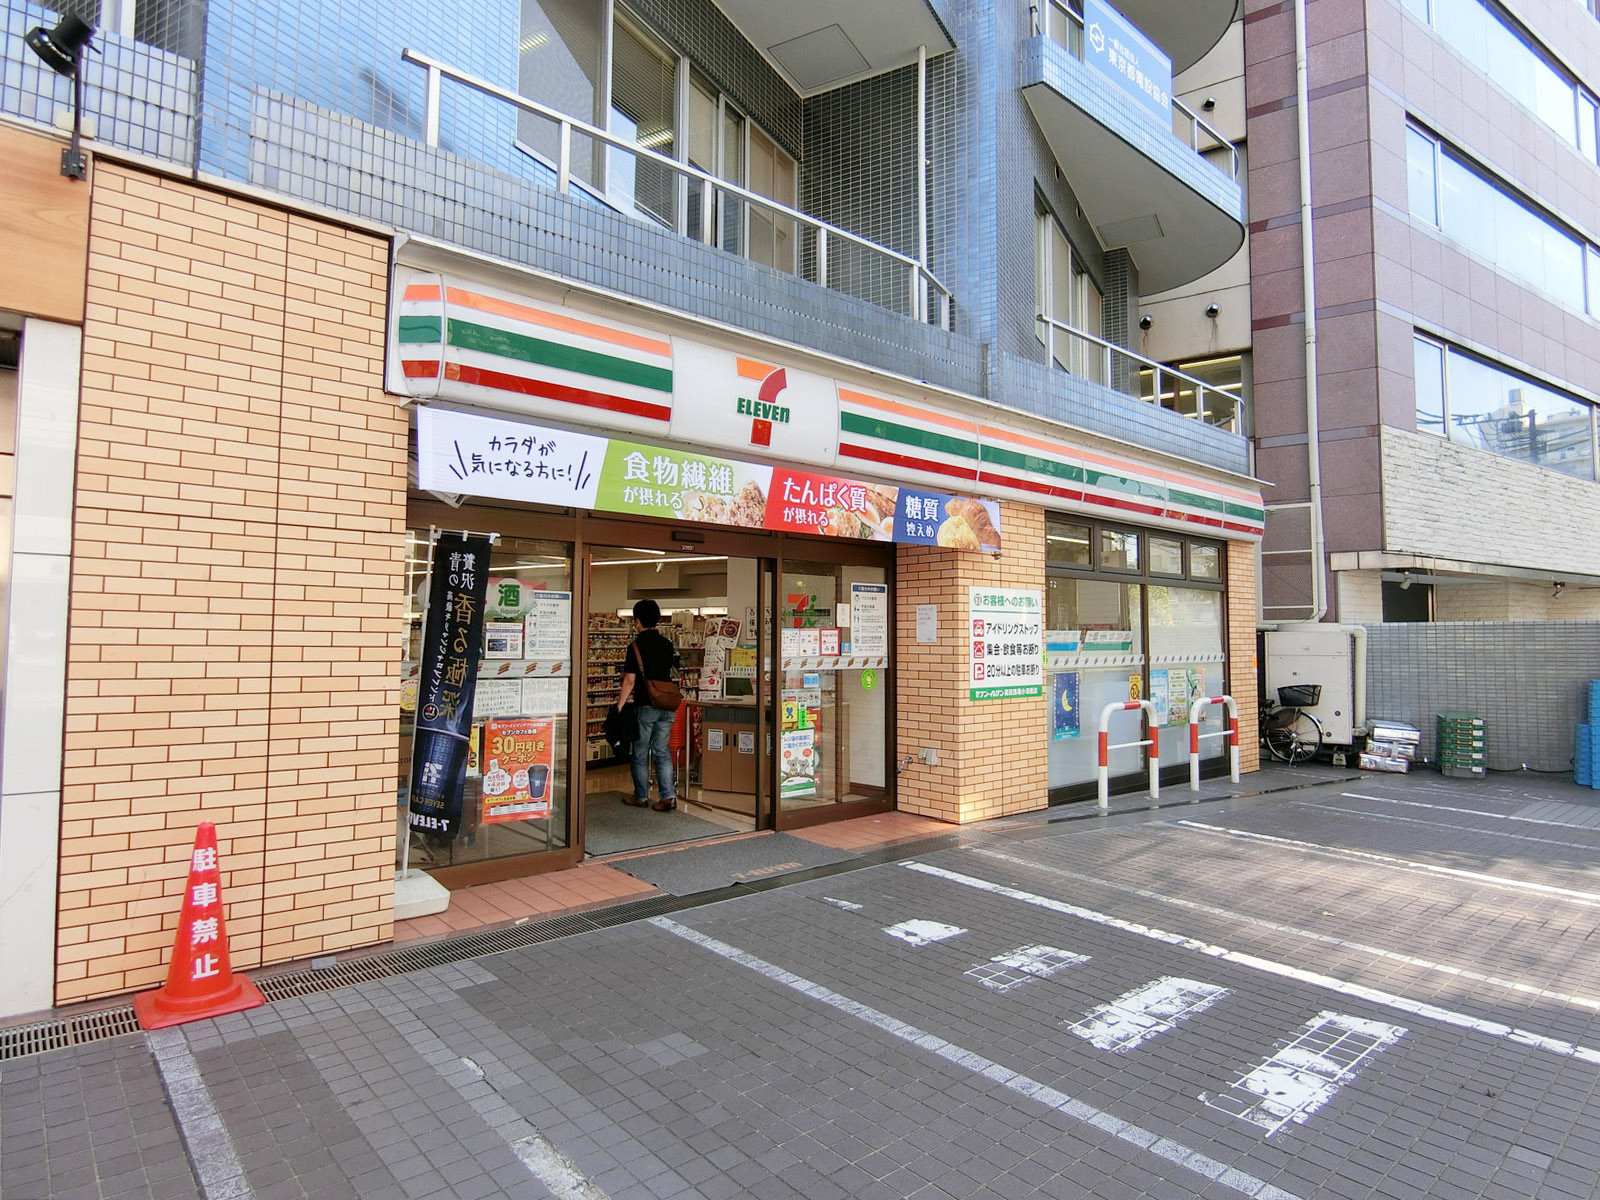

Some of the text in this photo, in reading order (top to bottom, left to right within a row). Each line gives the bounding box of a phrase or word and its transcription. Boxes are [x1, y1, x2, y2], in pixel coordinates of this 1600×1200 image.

[488, 434, 556, 454] カラダが
[622, 451, 735, 495] 食物繊維
[623, 486, 682, 512] が摂れる
[782, 477, 867, 512] たんぱく質
[783, 507, 829, 528] が摂れる
[905, 494, 938, 521] 糖質
[905, 520, 935, 539] 控えめ
[498, 583, 520, 607] 酒
[982, 595, 1038, 607] お客様へのお願い
[986, 622, 1039, 635] アイドリングストップ
[986, 664, 1040, 677] 20分以上の駐車お断り
[491, 736, 546, 755] 30円引き
[501, 753, 536, 765] クーポン
[192, 848, 220, 979] 駐車禁止
